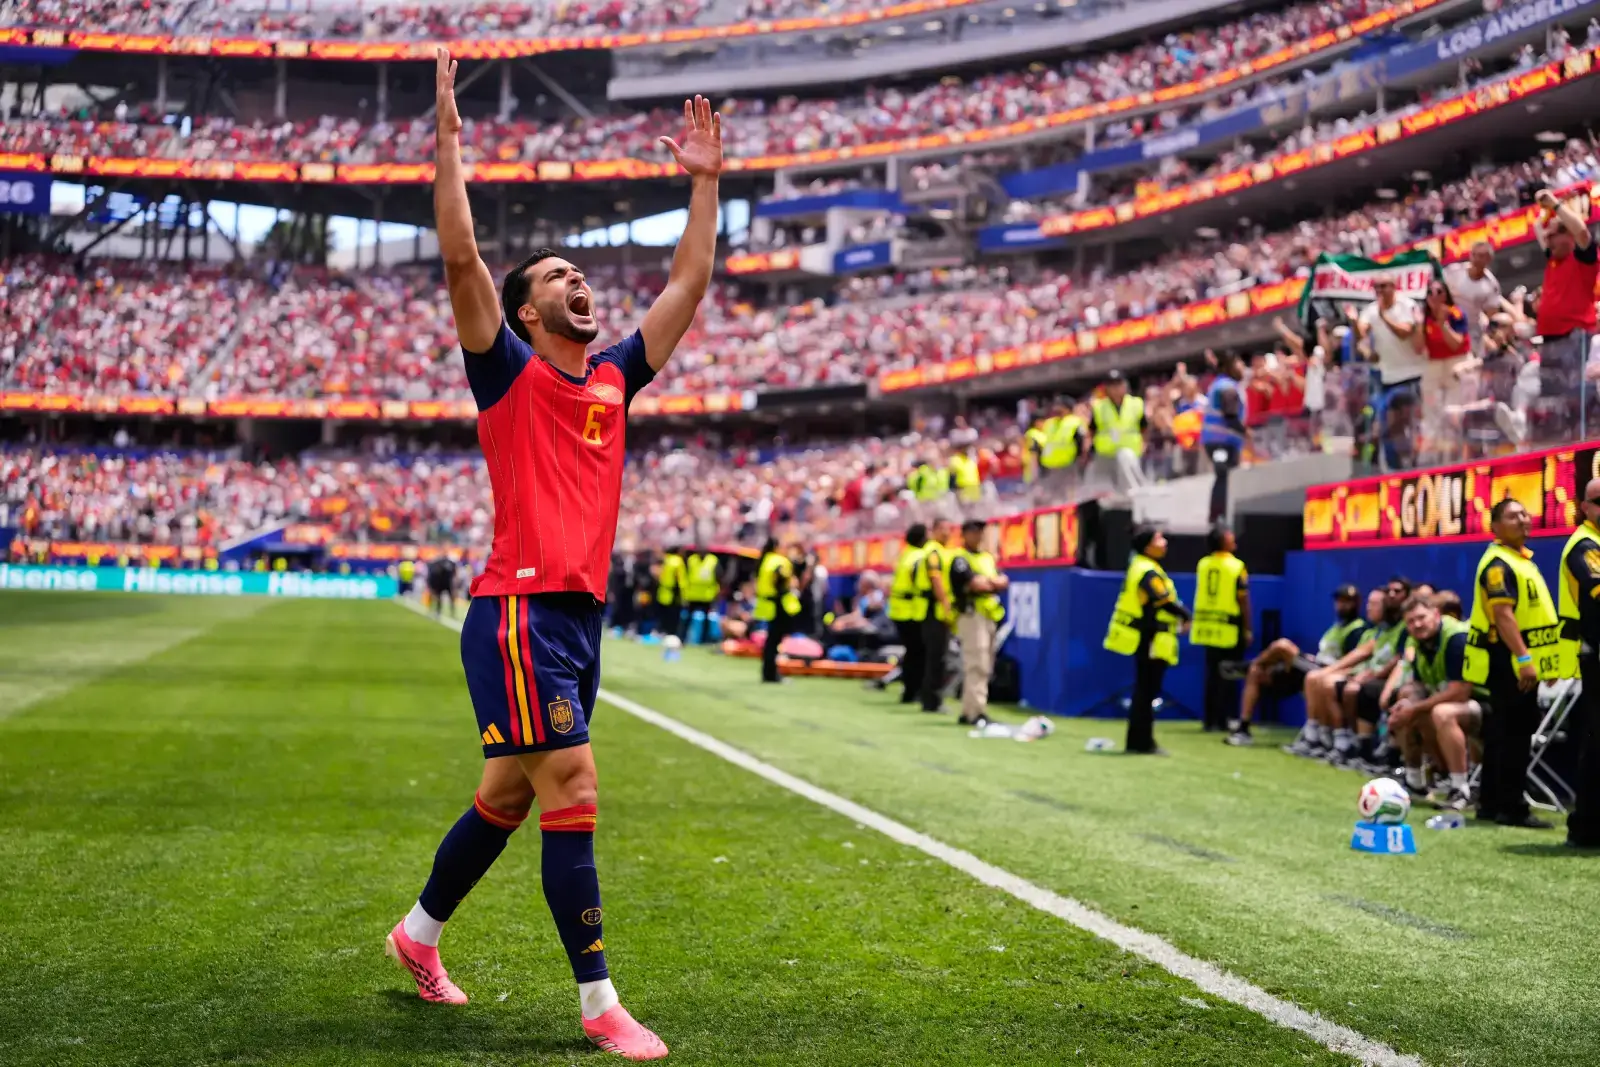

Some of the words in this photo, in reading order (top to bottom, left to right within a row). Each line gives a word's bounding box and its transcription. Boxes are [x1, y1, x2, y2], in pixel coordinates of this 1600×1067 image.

[1437, 25, 1482, 60] LOS
[1484, 0, 1592, 43] ANGELE
[583, 404, 603, 445] 6
[0, 563, 97, 590] isense
[123, 566, 243, 595] Hisense
[268, 570, 377, 598] Hisense
